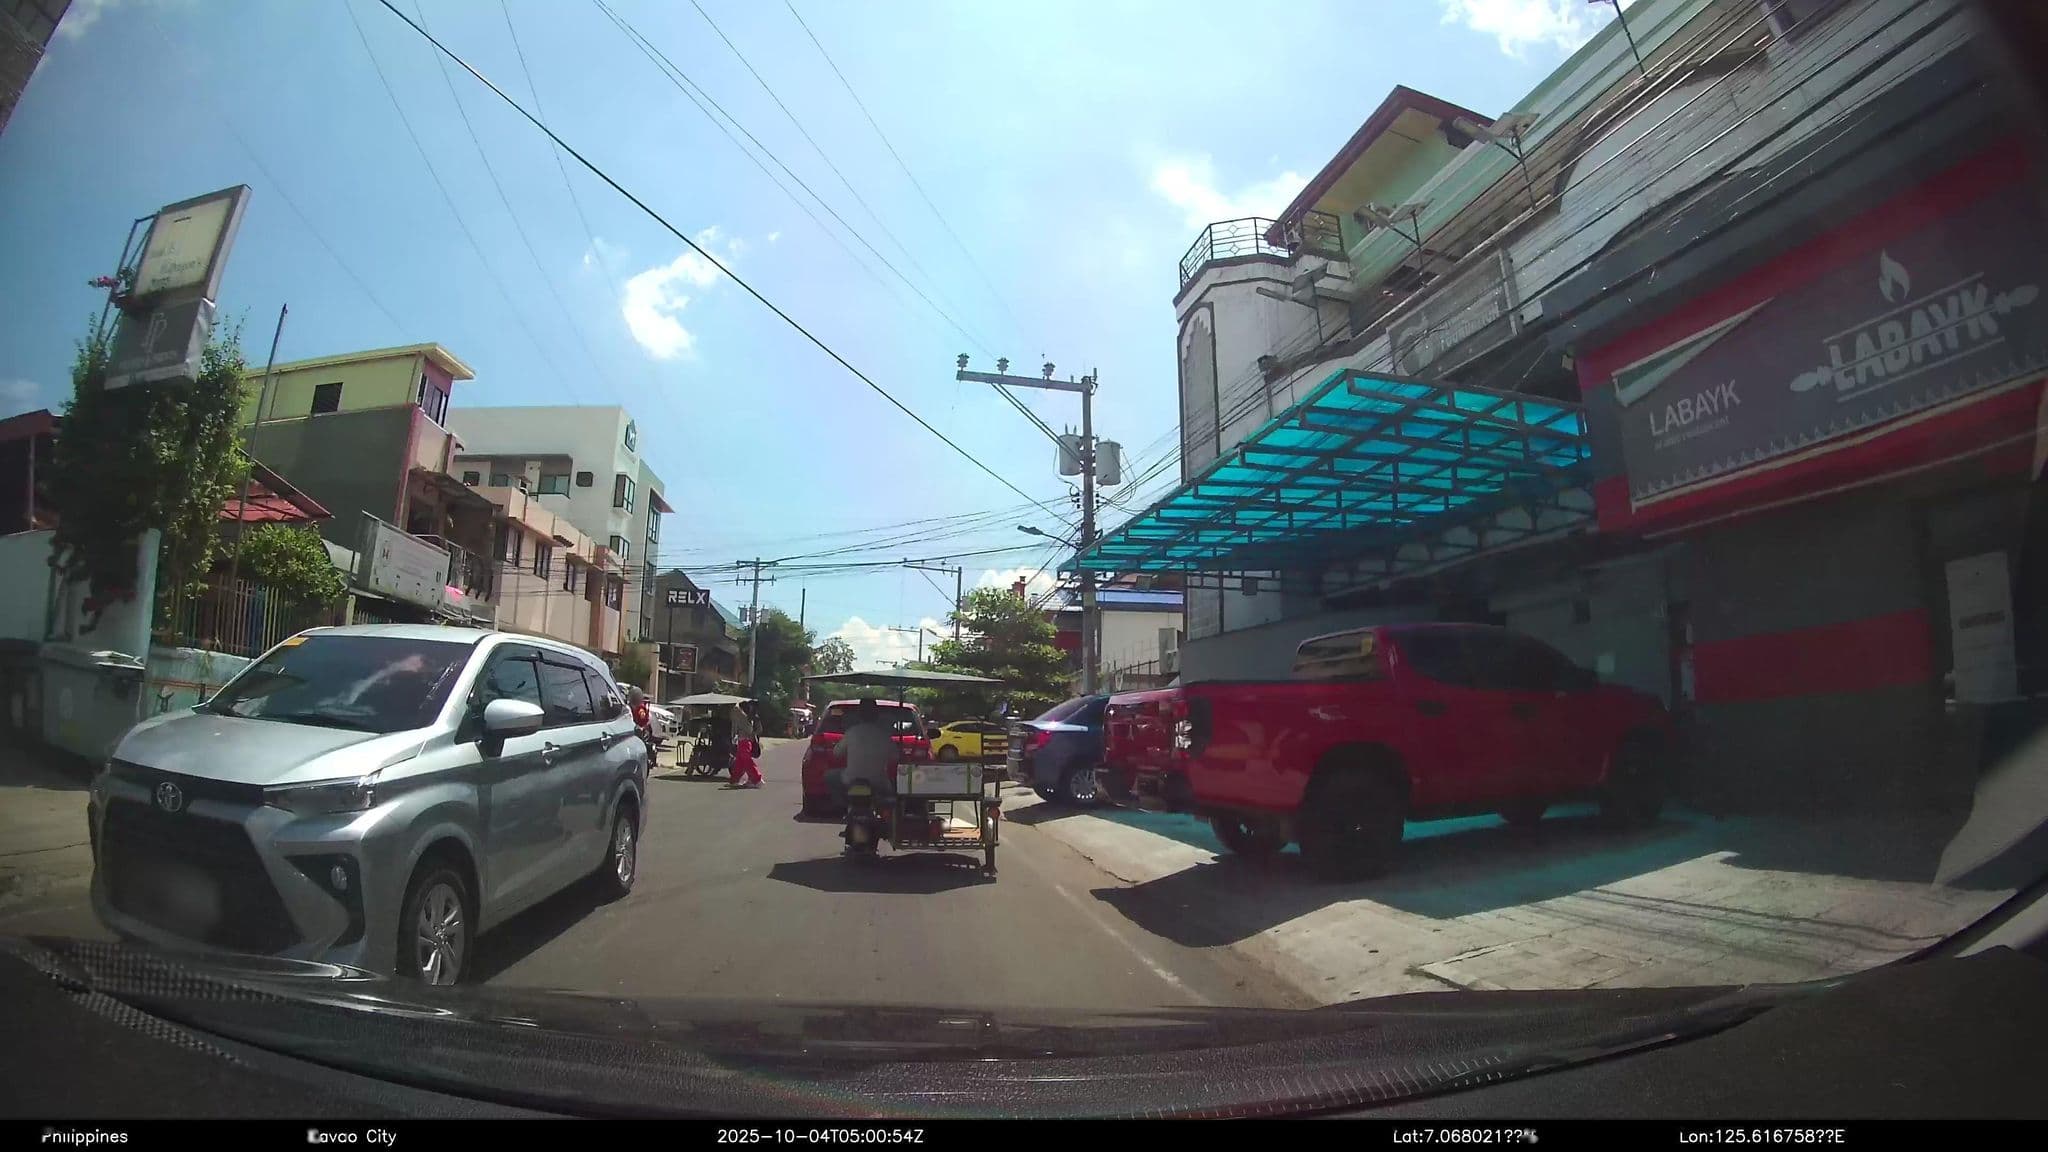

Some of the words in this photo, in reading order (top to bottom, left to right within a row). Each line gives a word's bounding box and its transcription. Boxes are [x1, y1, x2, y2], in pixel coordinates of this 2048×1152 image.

[1829, 282, 1998, 391] LABAYK
[1649, 378, 1742, 437] LABAYK
[668, 590, 706, 605] RELX
